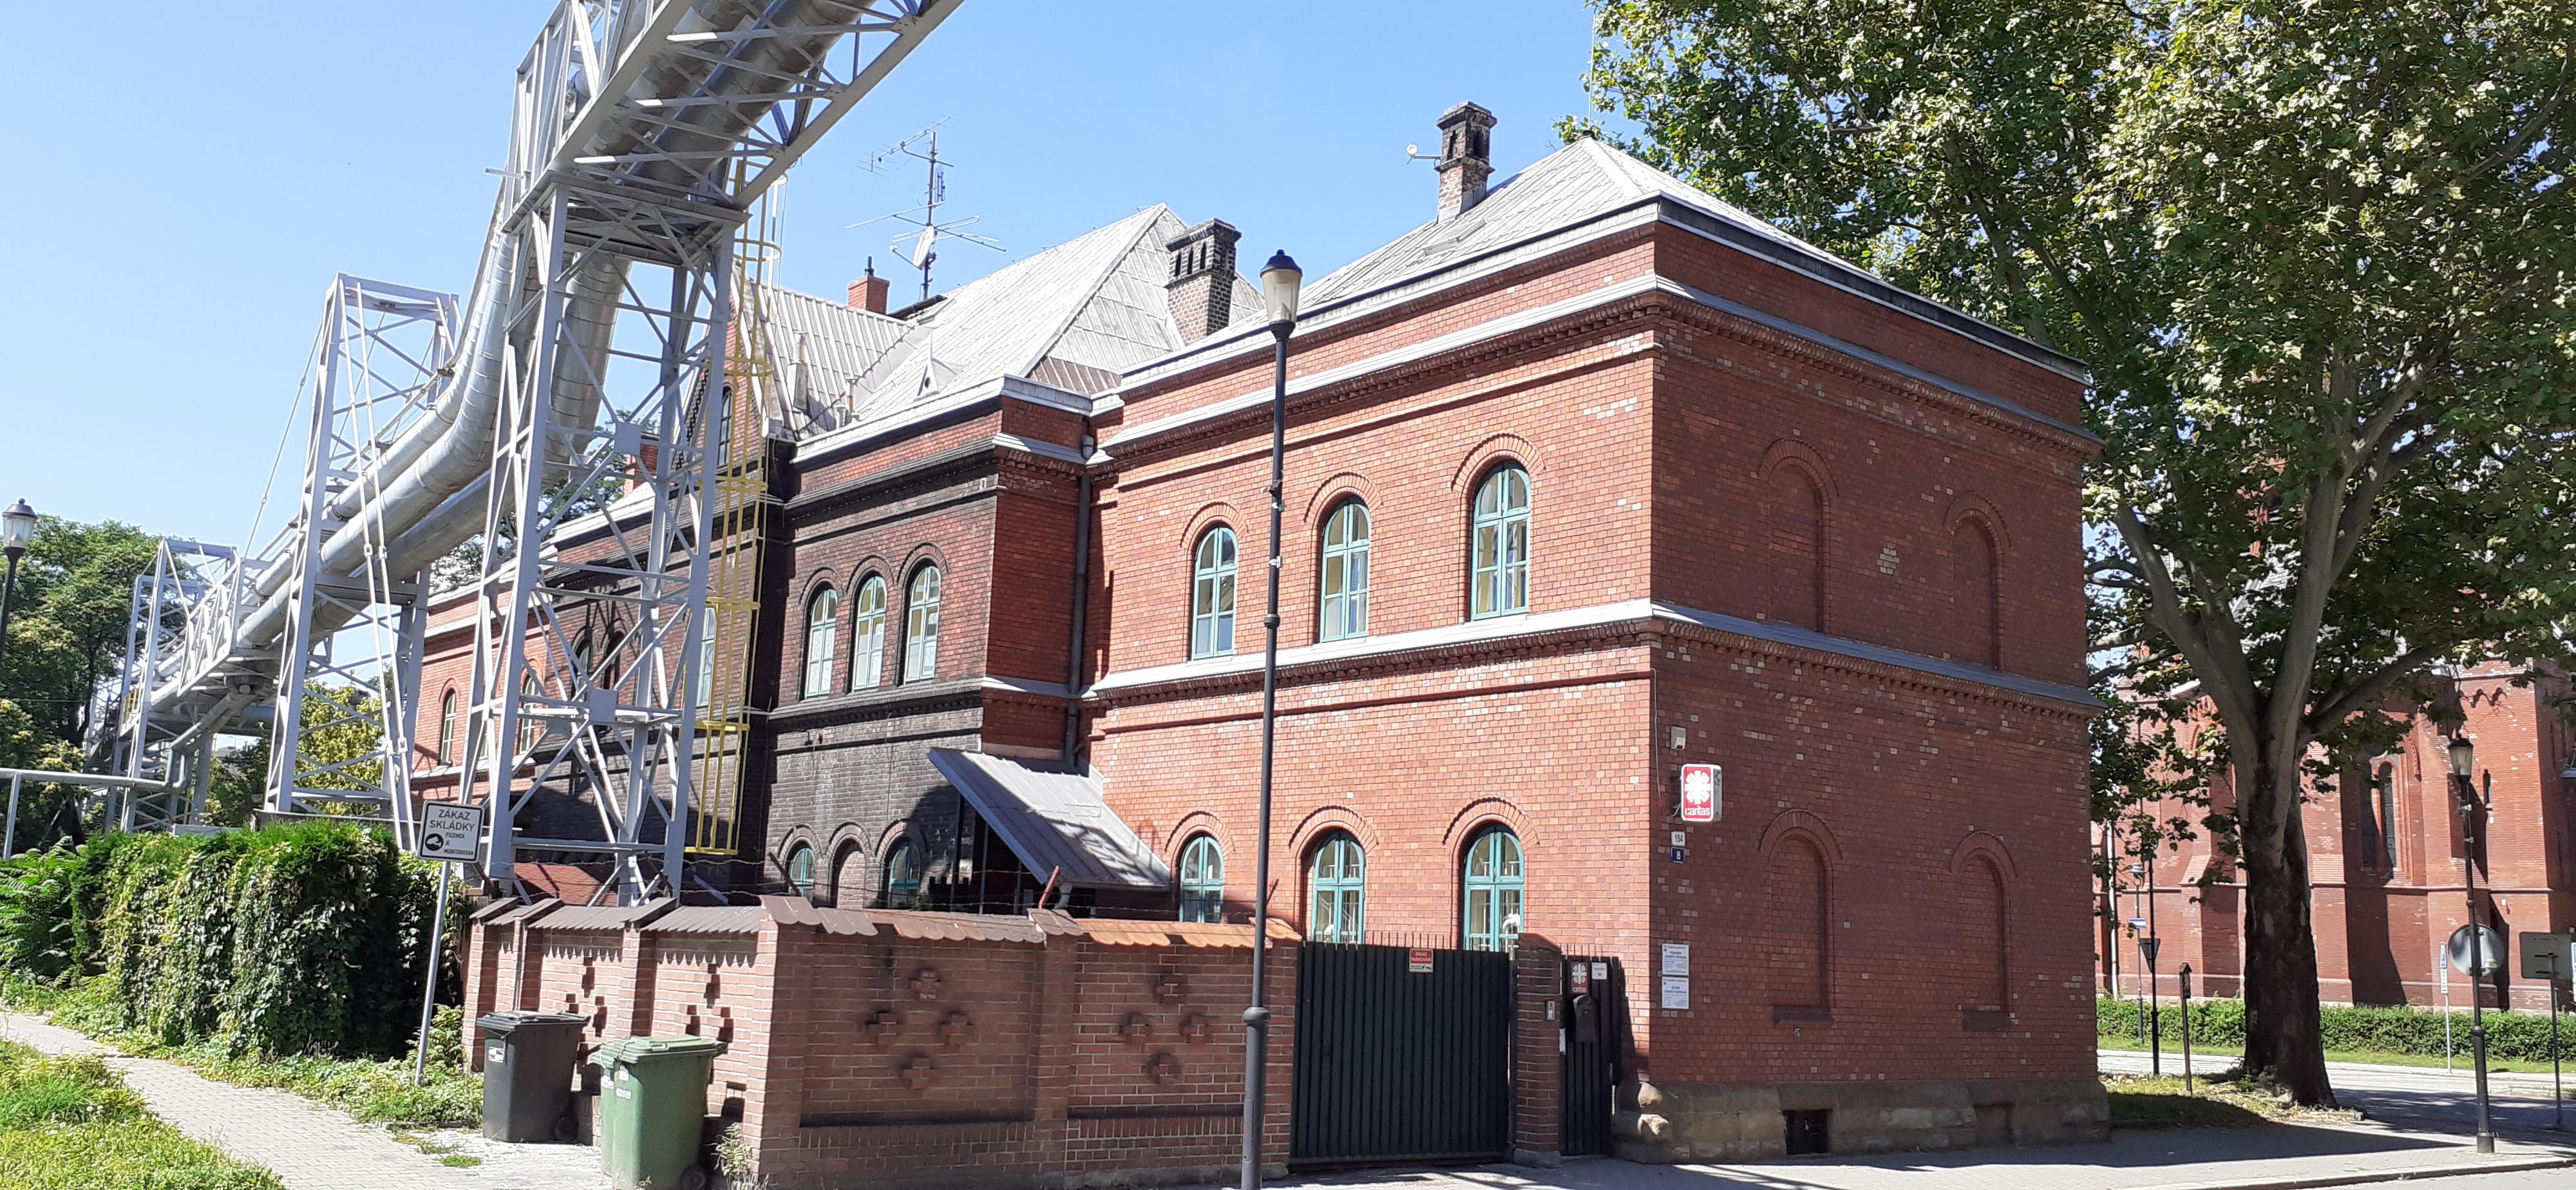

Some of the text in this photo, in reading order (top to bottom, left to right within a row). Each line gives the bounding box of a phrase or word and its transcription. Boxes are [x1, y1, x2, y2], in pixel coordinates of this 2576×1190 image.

[439, 809, 470, 820] ZÁKAZ
[1685, 806, 1710, 815] caritas
[430, 820, 475, 831] SKLÁDKY
[1674, 835, 1683, 843] 154
[1676, 851, 1681, 860] 8
